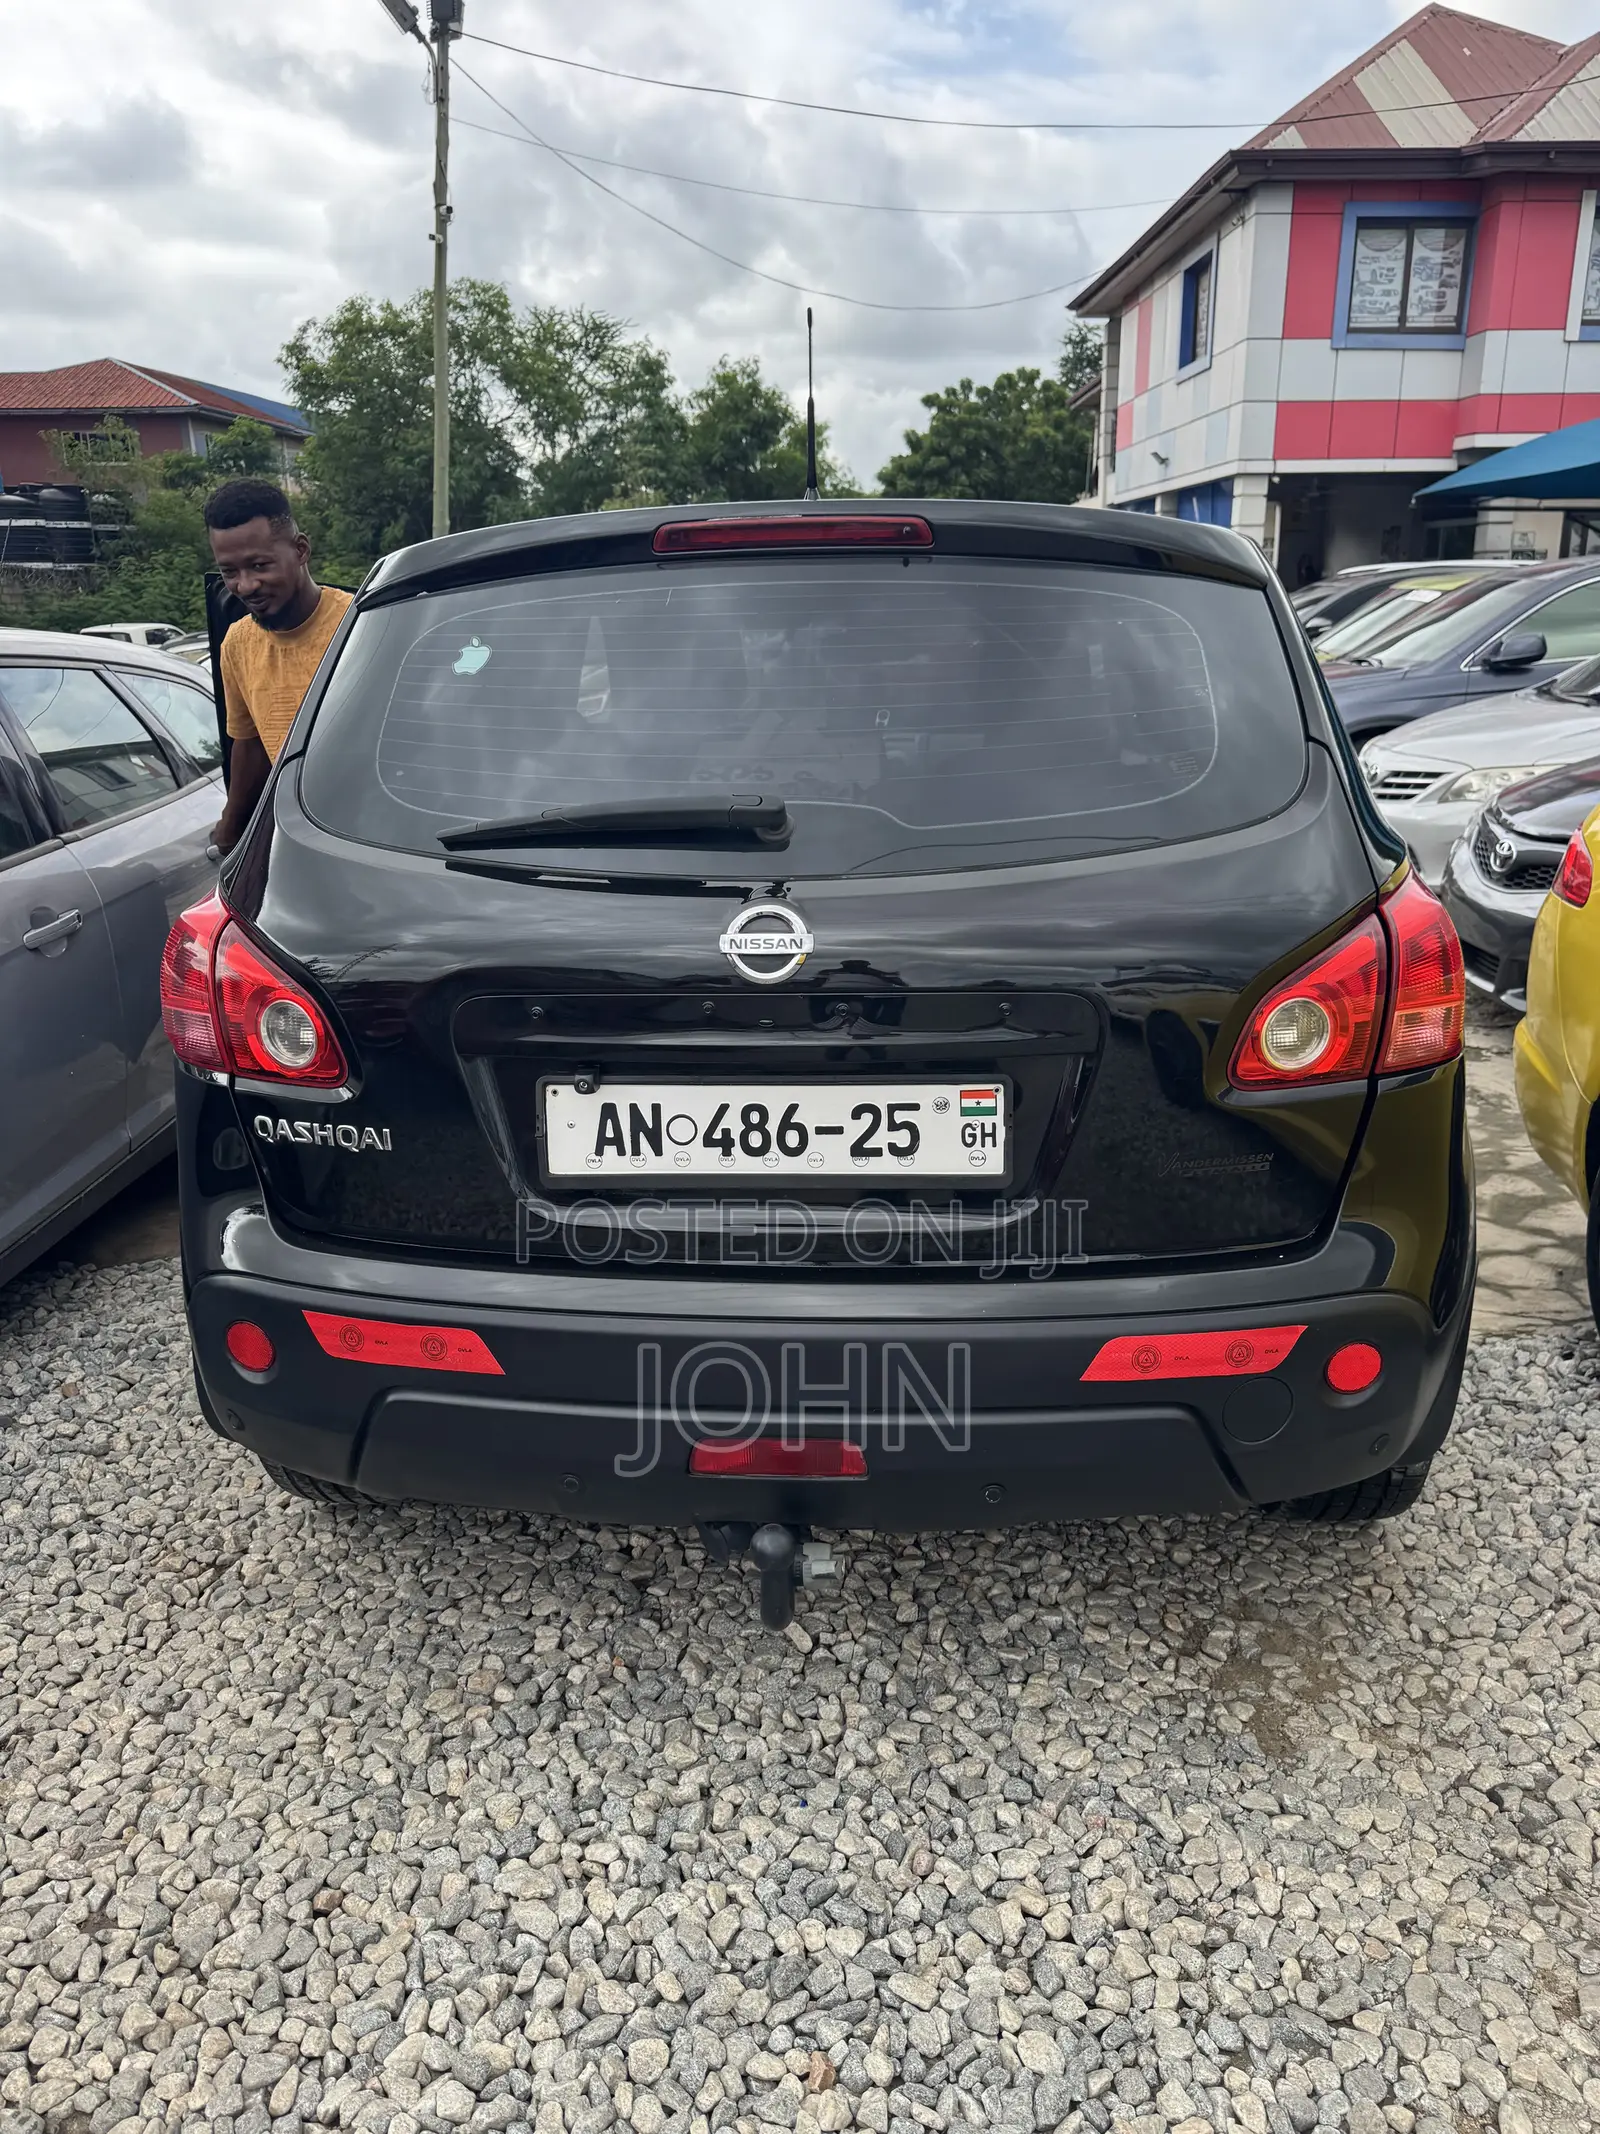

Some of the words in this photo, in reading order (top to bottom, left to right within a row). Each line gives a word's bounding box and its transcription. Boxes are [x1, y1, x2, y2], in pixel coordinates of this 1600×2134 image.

[729, 938, 803, 950] NISSAN
[253, 1115, 392, 1152] QASHQAI
[594, 1102, 664, 1157] AN
[702, 1102, 921, 1157] 486-25
[961, 1122, 997, 1148] GH
